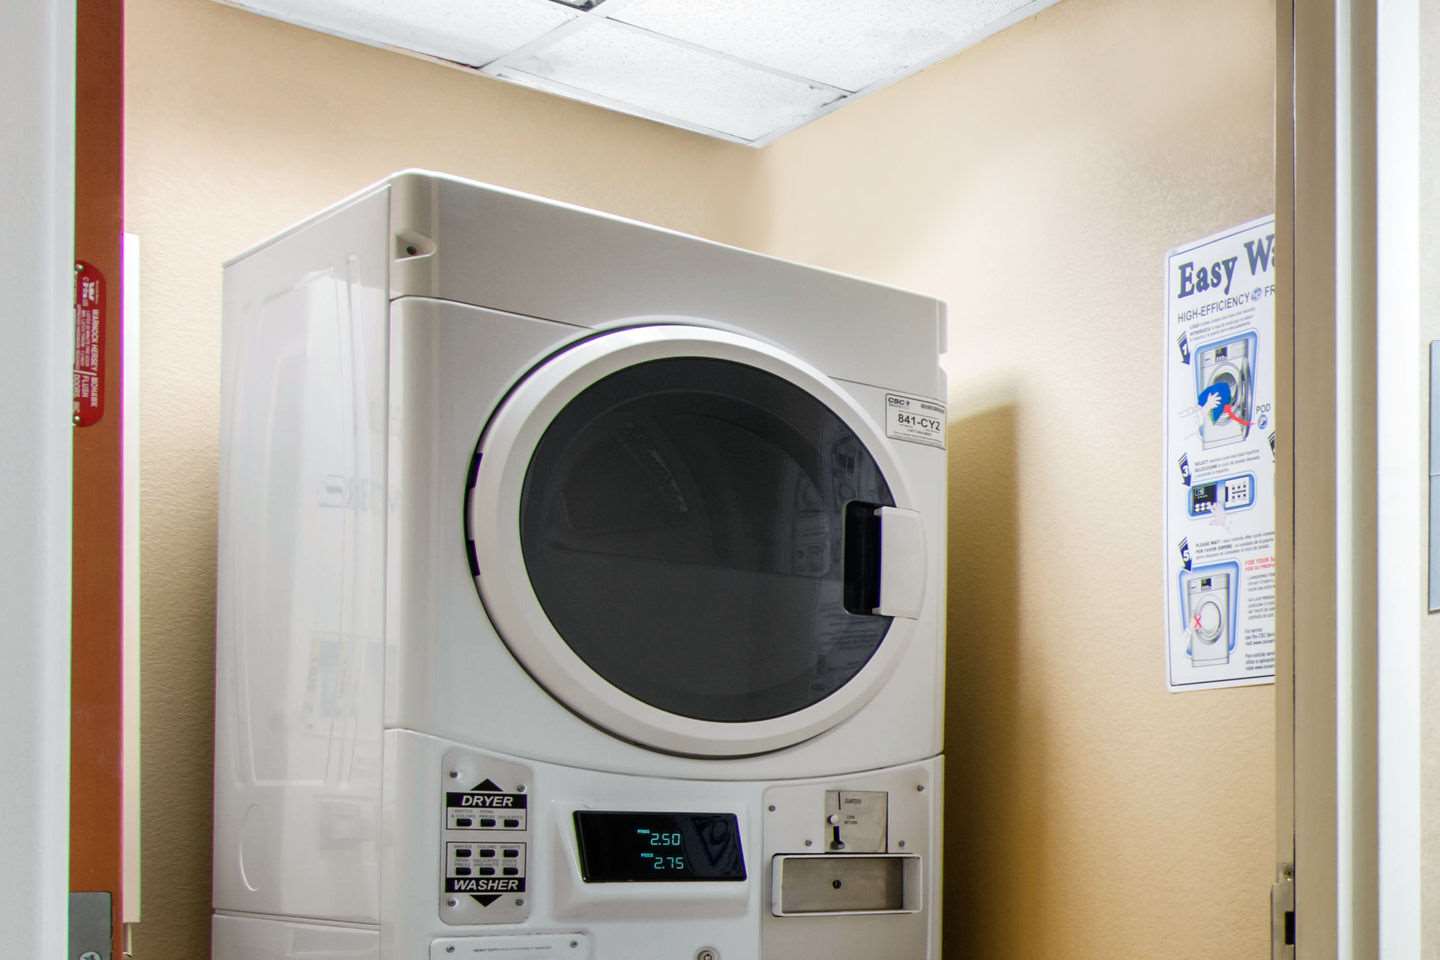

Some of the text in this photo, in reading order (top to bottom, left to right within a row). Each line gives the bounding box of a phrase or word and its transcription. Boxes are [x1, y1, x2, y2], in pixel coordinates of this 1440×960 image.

[1177, 235, 1274, 299] Easy W
[1178, 292, 1250, 323] HIGH-EFFICIENCY
[462, 795, 513, 807] DRYER
[650, 833, 681, 846] 2.50
[654, 857, 684, 869] 2.75
[454, 879, 518, 890] WASHER
